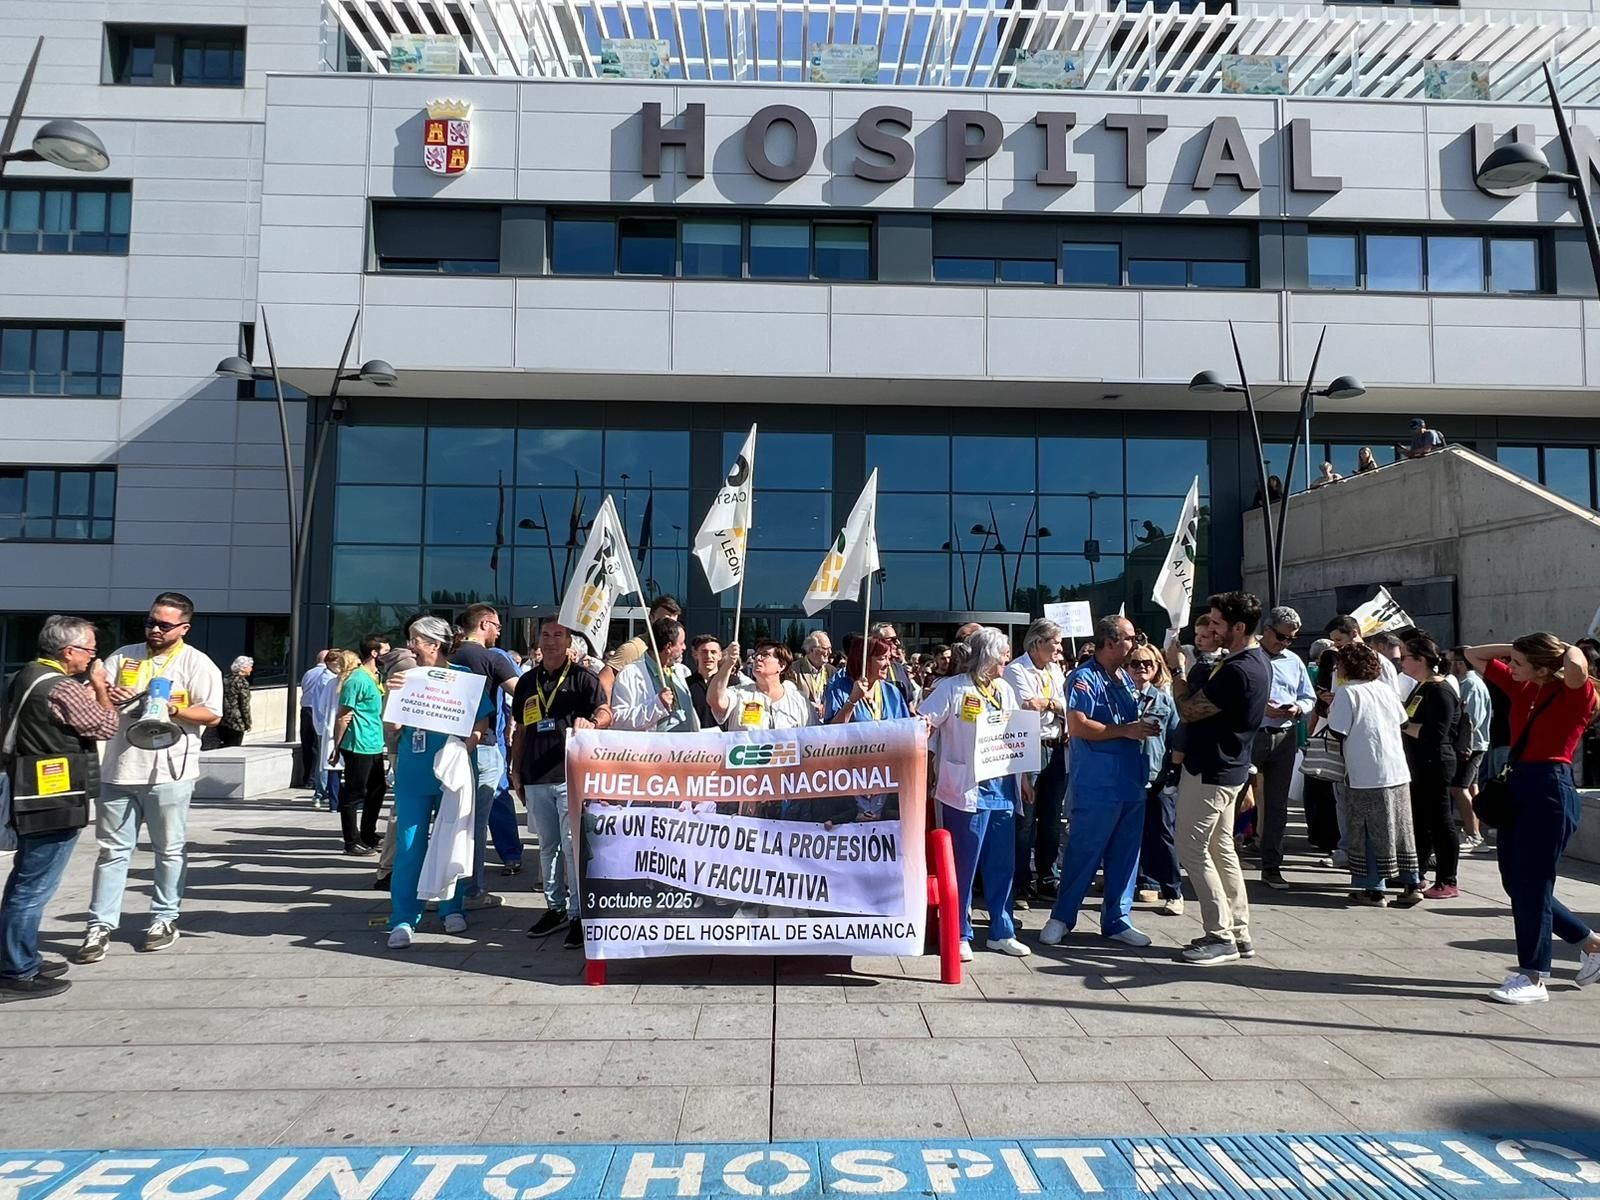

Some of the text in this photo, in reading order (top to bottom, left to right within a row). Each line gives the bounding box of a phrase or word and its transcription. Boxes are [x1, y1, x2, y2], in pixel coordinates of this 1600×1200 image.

[641, 102, 1342, 193] HOSPITAL
[401, 698, 430, 708] FORZOSA
[442, 706, 466, 715] MANOS
[591, 743, 886, 766] Sindicato Médico CESM Salamanca
[584, 766, 899, 797] HUELGA MÉDICA NACIONAL
[622, 815, 646, 837] UN
[651, 816, 730, 849] ESTATUTO
[734, 826, 759, 852] DE
[761, 830, 783, 857] LA
[788, 828, 897, 862] PROFESIÓN
[635, 846, 830, 903] MÉDICA Y FACULTATIVA
[587, 892, 693, 909] 3 octubre 2025
[584, 922, 917, 941] EDICO/AS DEL HOSPITAL DE SALAMANCA
